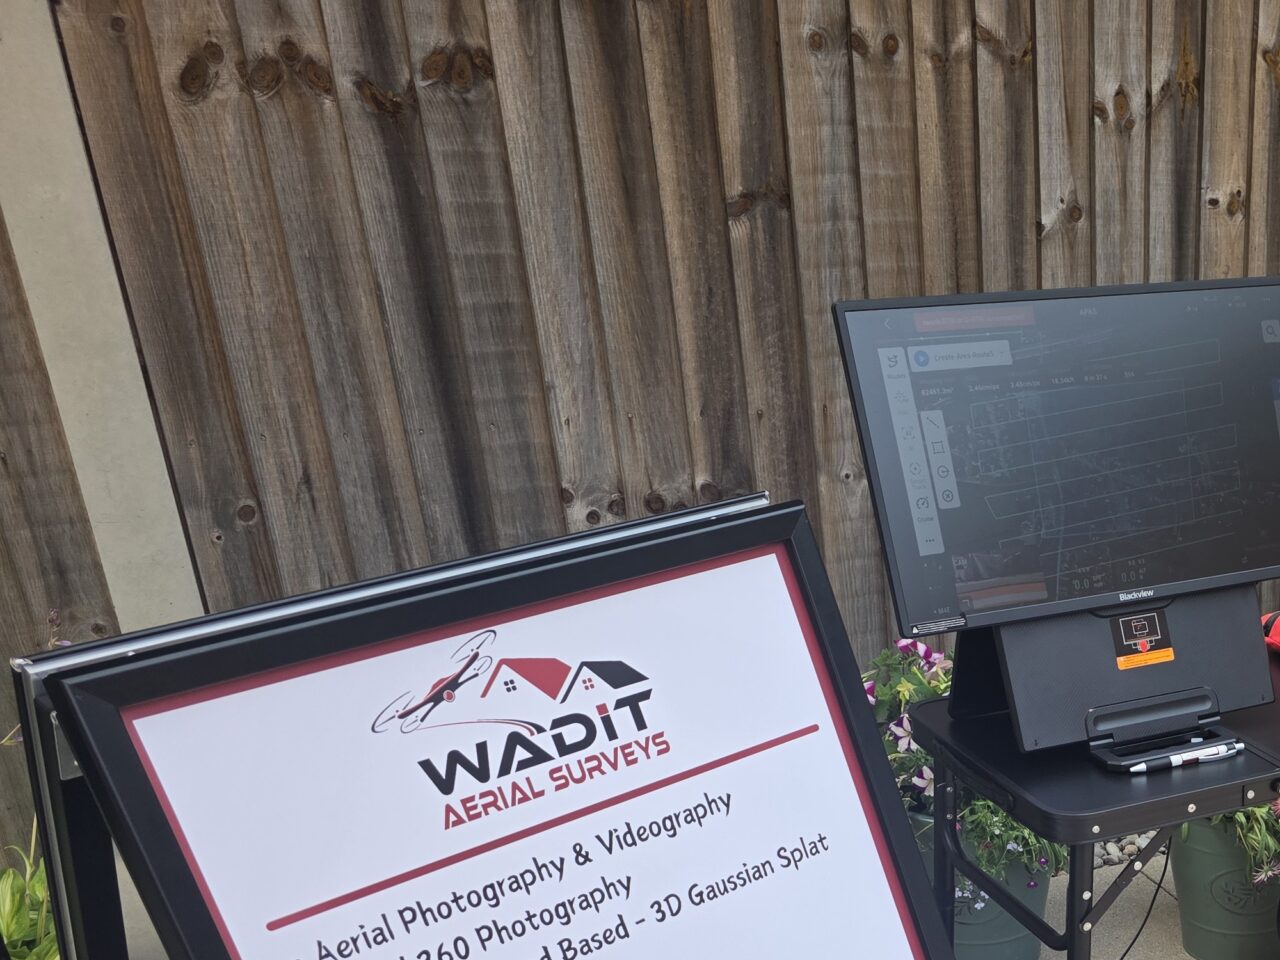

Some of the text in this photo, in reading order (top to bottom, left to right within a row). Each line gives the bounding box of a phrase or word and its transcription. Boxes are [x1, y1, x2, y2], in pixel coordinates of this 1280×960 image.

[1119, 589, 1154, 602] Blackview
[444, 731, 671, 830] AERIAL SURVEYS
[397, 857, 565, 934] Photography
[572, 843, 593, 866] &
[594, 793, 731, 855] Videography
[650, 894, 681, 922] 3D
[688, 860, 774, 906] Gaussian
[777, 833, 828, 871] Splat
[475, 876, 631, 952] Photography
